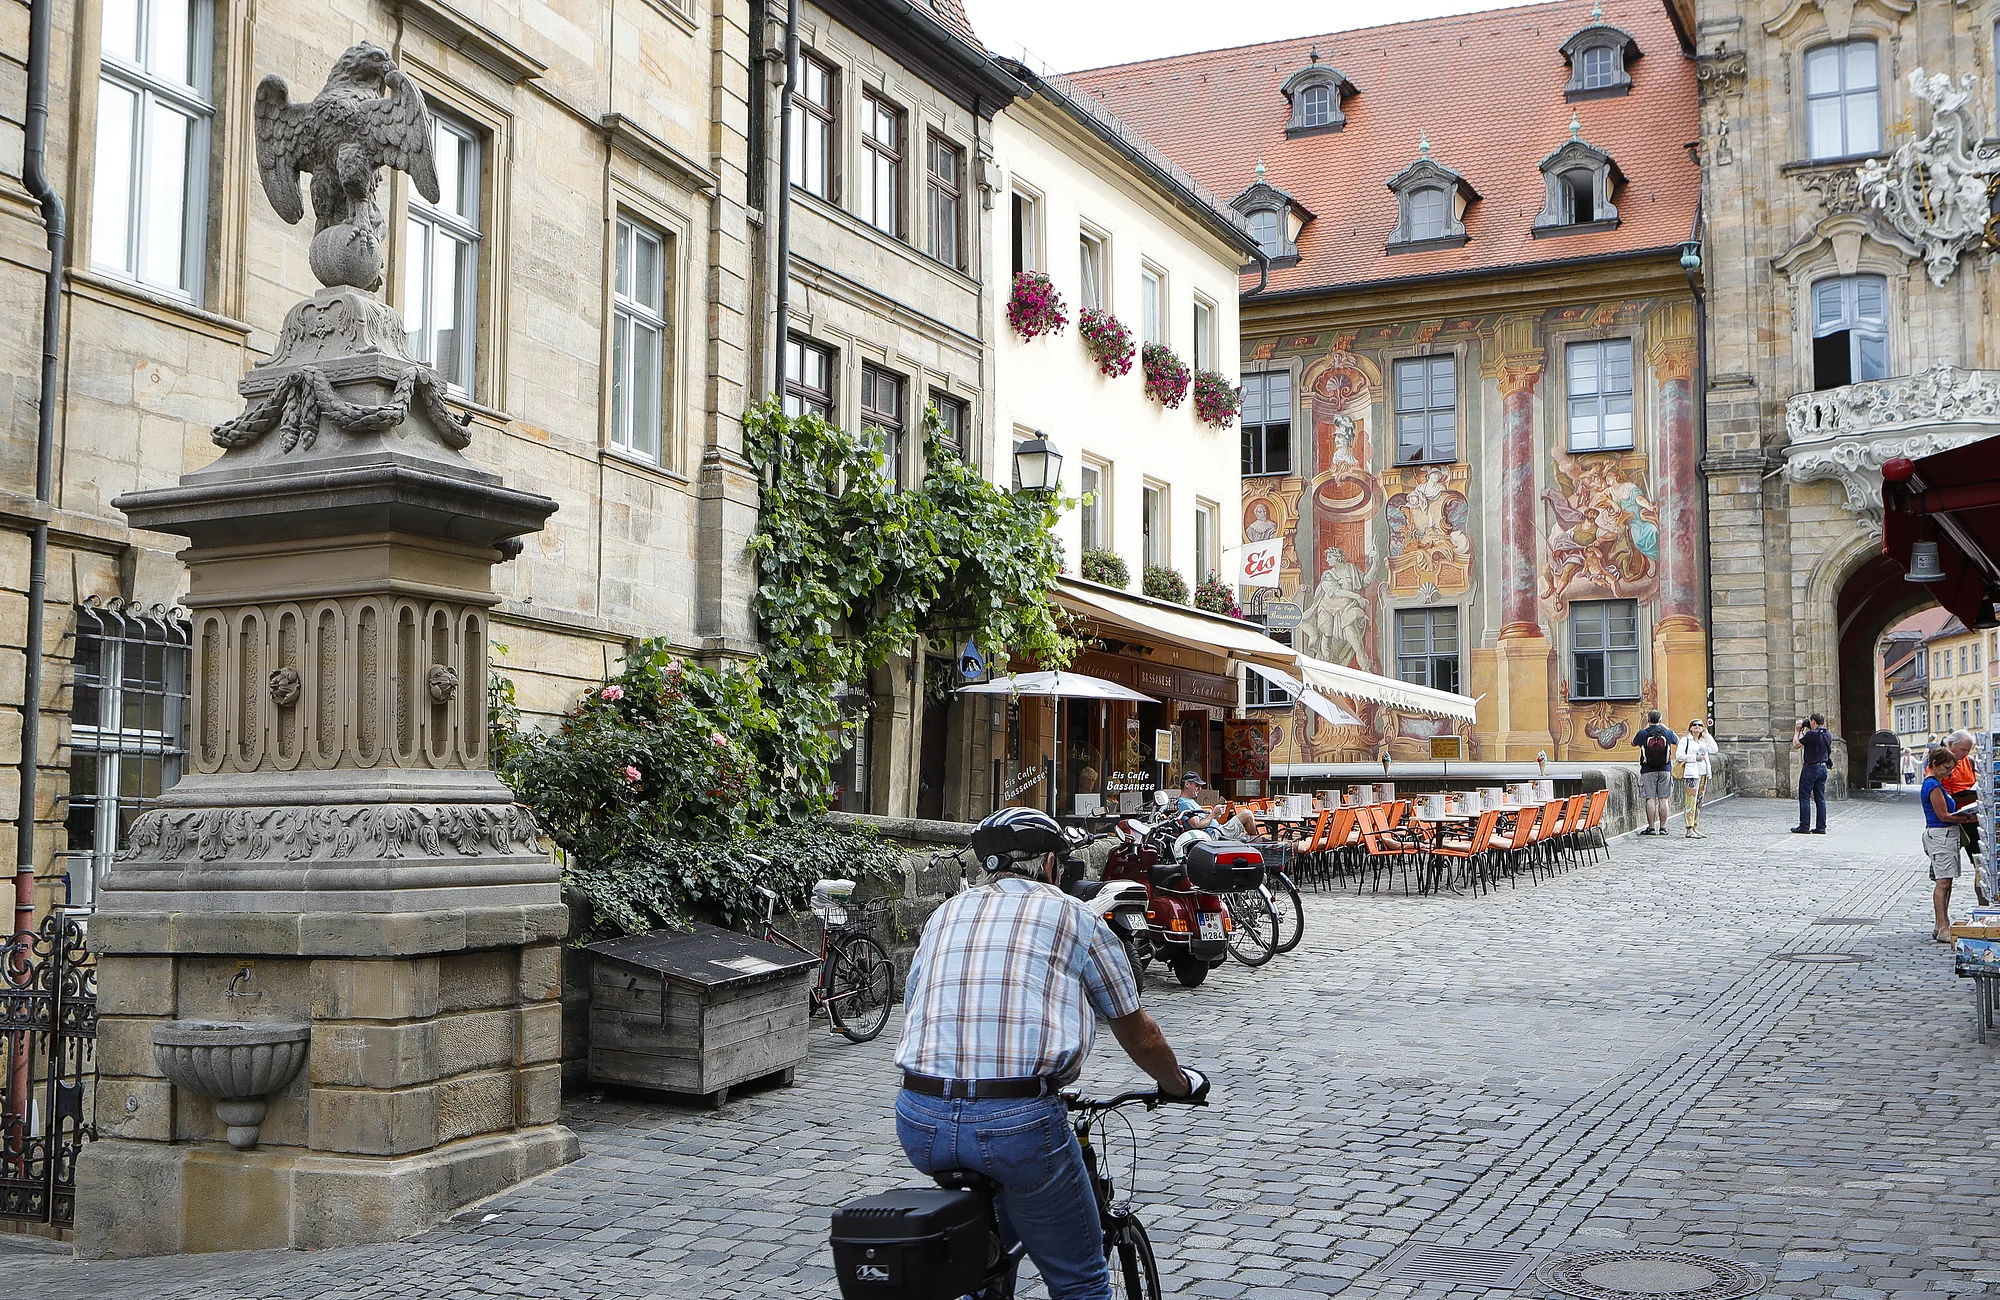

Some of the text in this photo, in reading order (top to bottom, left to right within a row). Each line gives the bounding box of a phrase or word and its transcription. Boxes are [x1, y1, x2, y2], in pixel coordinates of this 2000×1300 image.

[1245, 550, 1275, 576] Eis
[1142, 671, 1172, 687] BASSANESE
[1112, 771, 1125, 779] Eis
[1004, 778, 1016, 789] Eis
[1004, 771, 1046, 801] Bassanese
[1106, 780, 1156, 791] Bassanese
